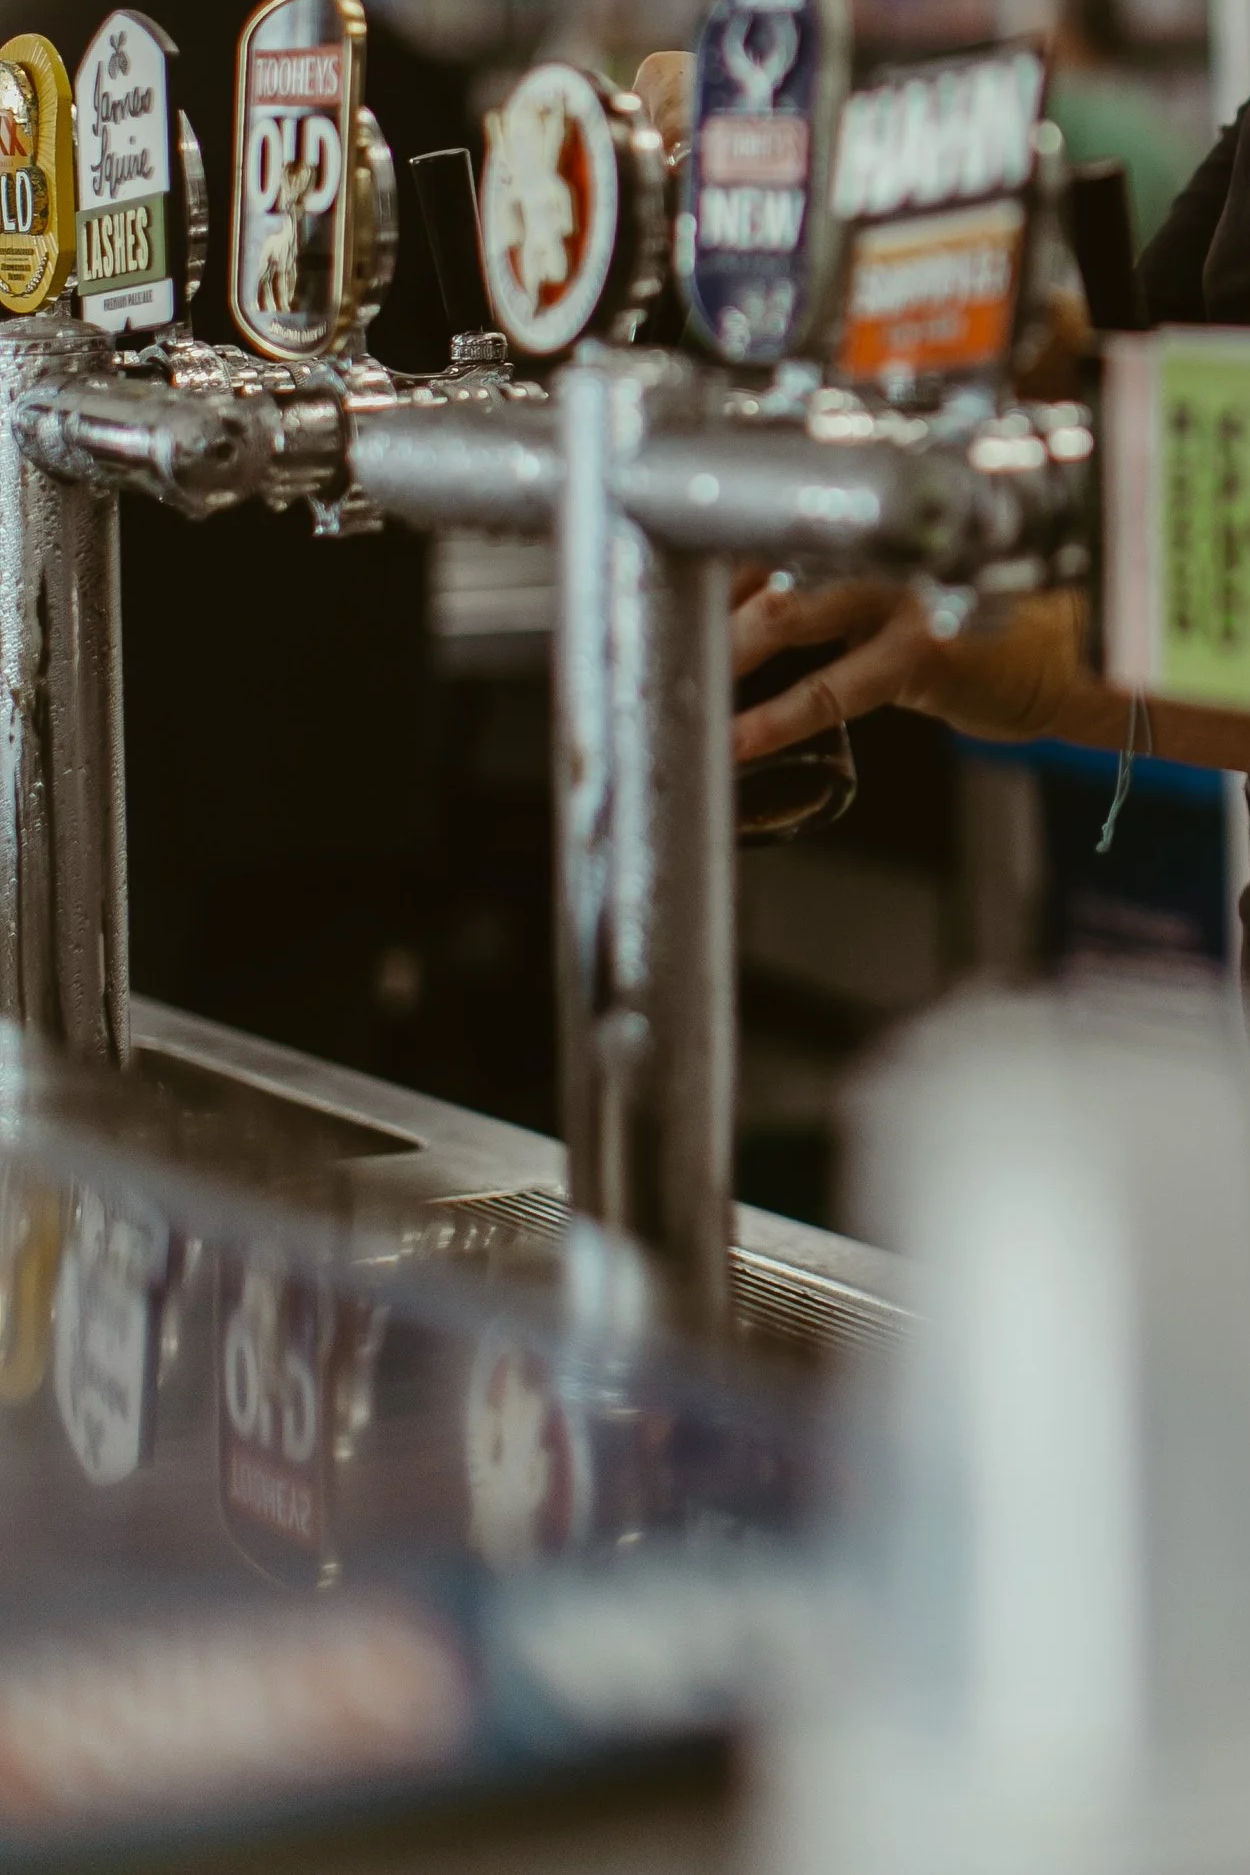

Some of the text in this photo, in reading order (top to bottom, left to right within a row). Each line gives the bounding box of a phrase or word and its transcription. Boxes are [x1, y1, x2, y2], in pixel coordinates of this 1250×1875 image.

[256, 54, 340, 97] TOOHEYS
[91, 124, 156, 199] Squire
[83, 206, 149, 281] LASHES
